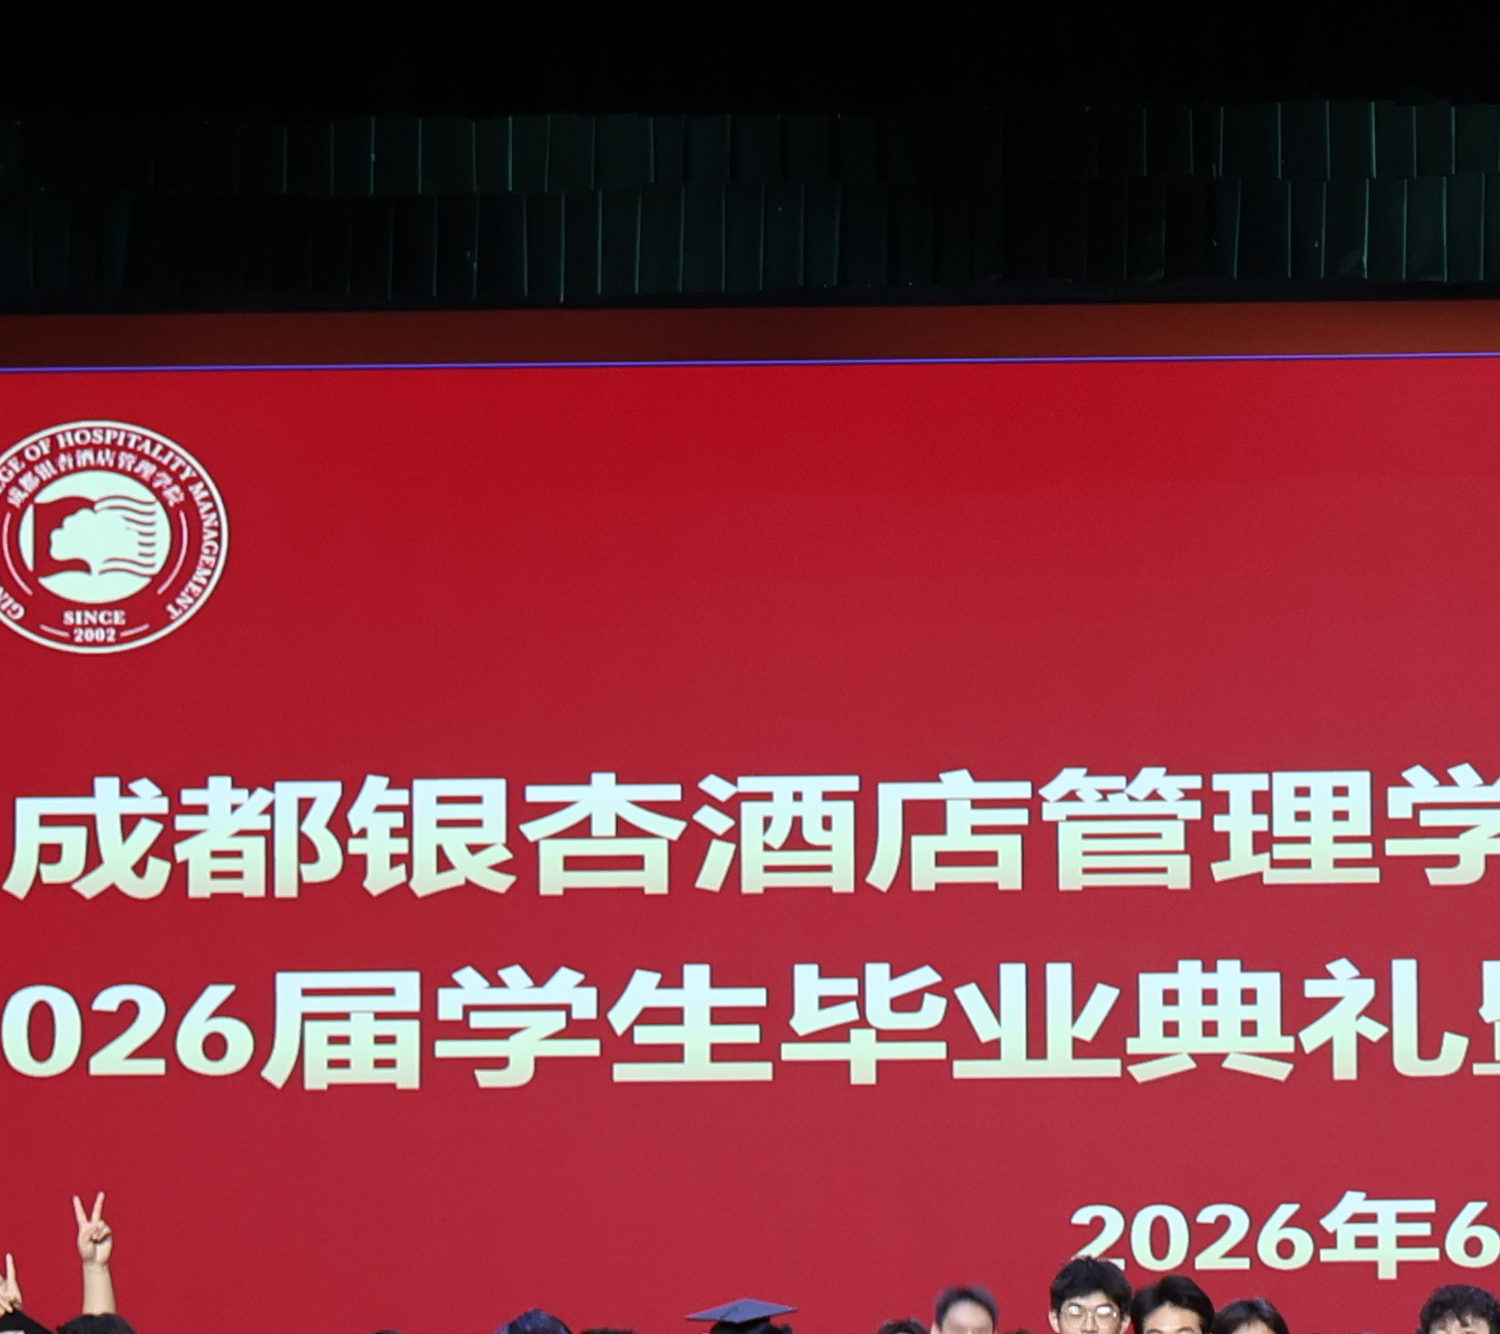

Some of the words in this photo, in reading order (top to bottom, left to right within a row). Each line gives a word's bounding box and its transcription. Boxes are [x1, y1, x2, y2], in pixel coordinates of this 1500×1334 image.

[24, 437, 51, 462] OF
[56, 428, 196, 481] HOSPITALITY
[165, 481, 219, 620] MANAGEMENT
[63, 610, 126, 625] SINCE
[73, 627, 116, 643] 2002
